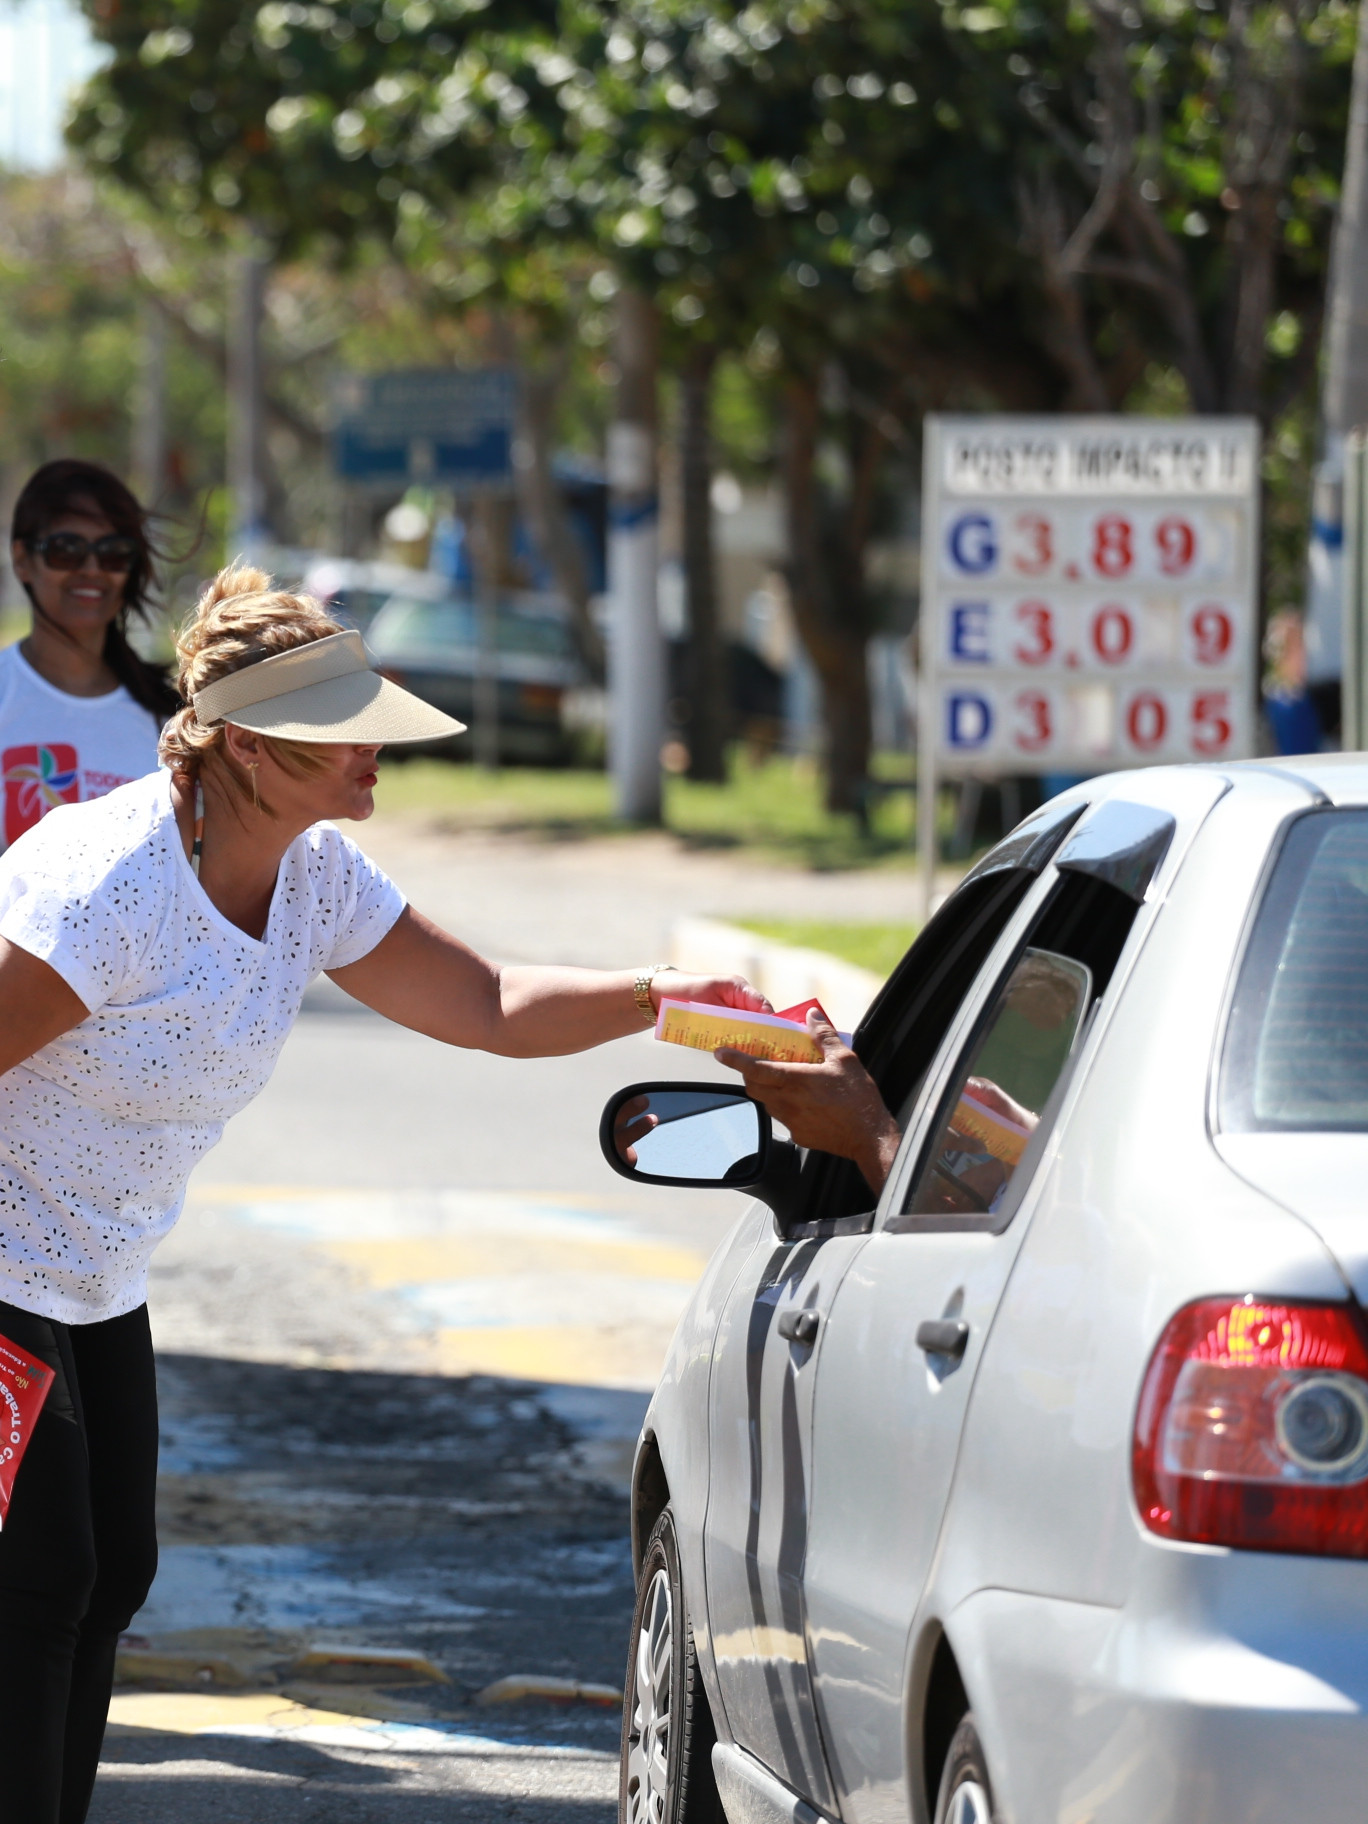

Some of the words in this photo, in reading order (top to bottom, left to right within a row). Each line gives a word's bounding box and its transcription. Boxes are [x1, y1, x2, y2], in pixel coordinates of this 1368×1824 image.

[946, 511, 999, 578] G
[949, 600, 993, 665] E
[946, 692, 994, 754] D
